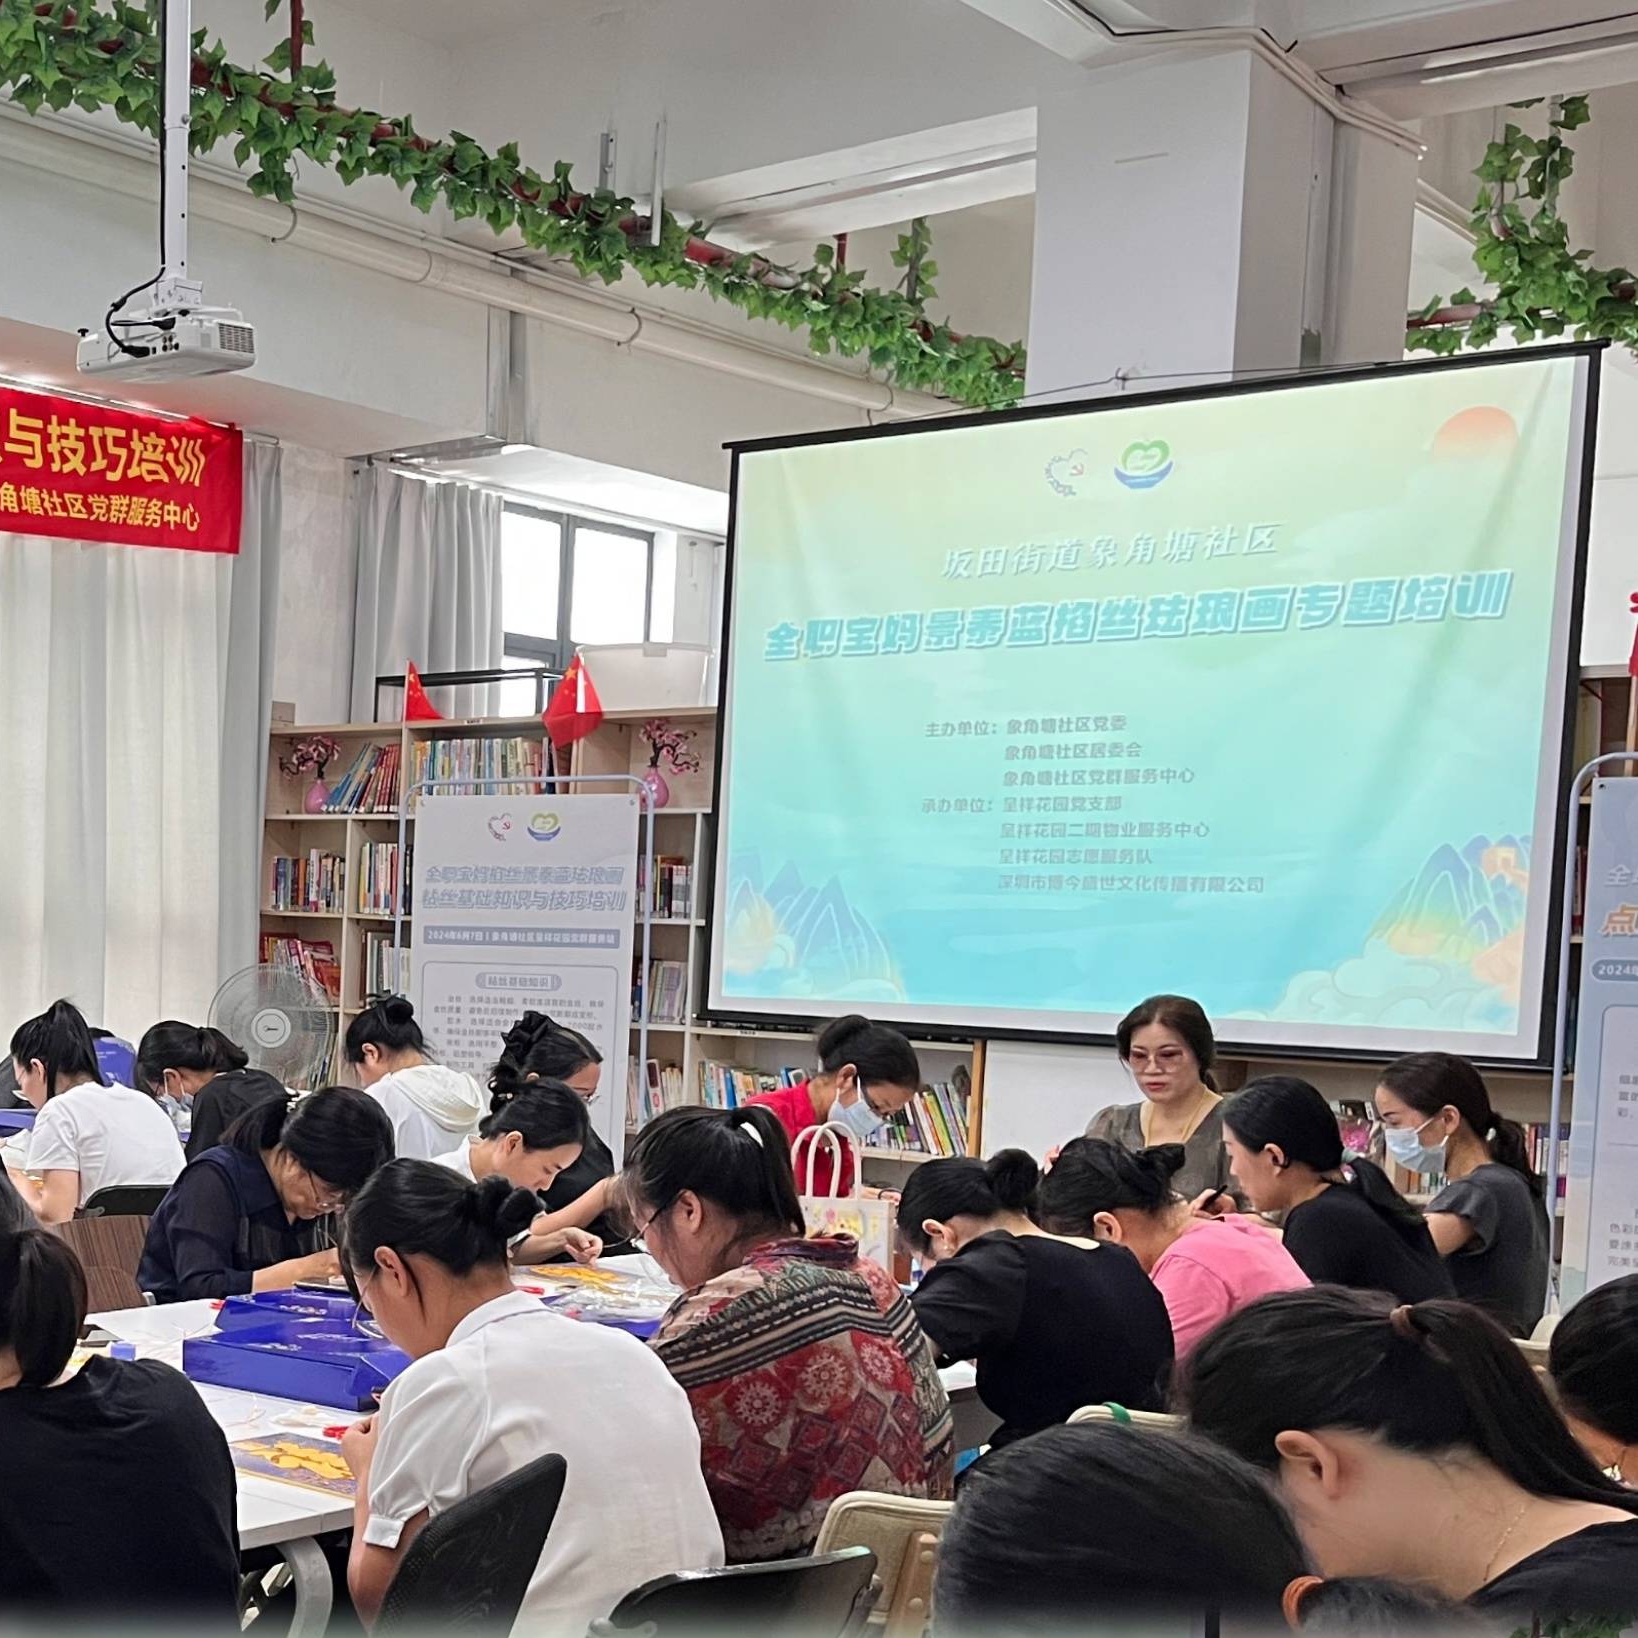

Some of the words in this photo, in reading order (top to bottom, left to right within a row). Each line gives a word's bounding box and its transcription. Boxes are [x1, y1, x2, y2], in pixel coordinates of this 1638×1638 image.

[942, 523, 1282, 580] 坂田街道象角塘社区
[764, 568, 1514, 662] 全职宝妈景泰蓝掐丝珐琅画专题培训
[1004, 742, 1143, 762] 象角塘社区居委会
[1003, 768, 1195, 787] 象角塘社区党群服务中心
